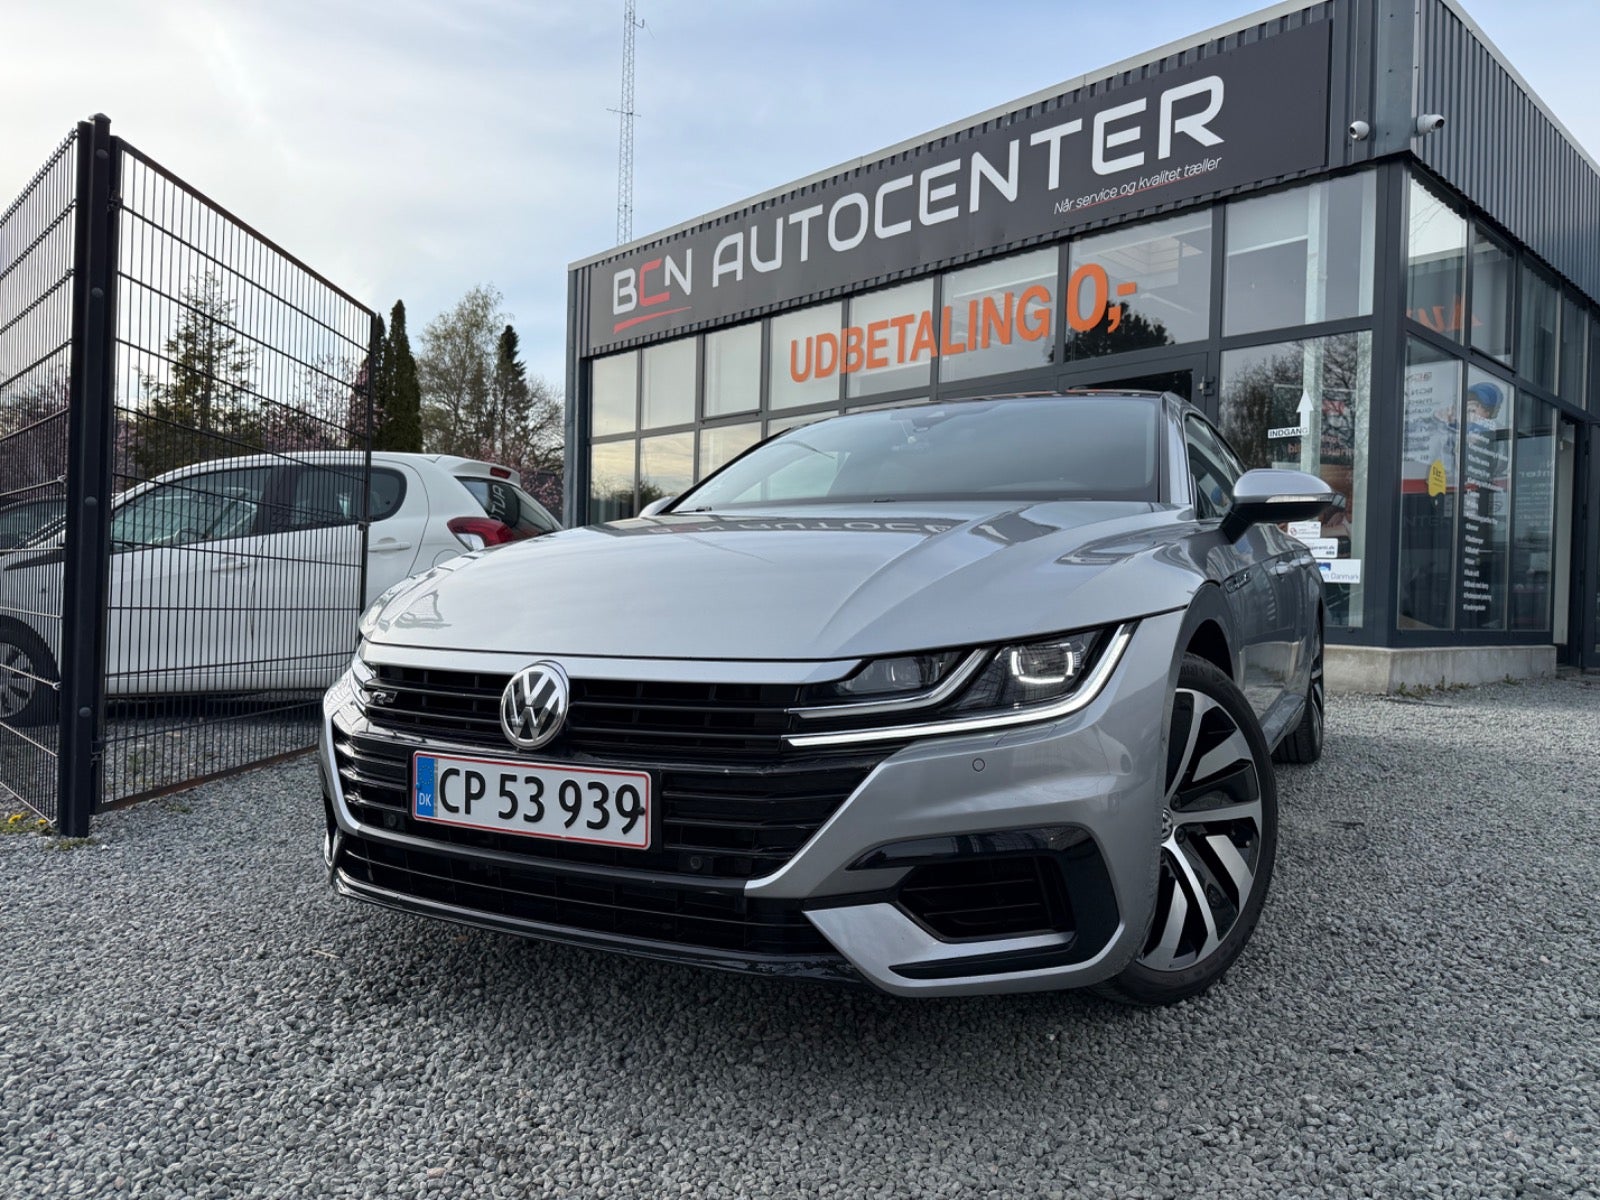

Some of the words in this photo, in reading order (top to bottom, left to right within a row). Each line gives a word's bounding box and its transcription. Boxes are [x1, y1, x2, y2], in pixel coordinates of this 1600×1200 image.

[613, 248, 692, 315] BCN
[712, 75, 1225, 288] AUTOCENTER
[1053, 198, 1074, 215] Når
[1075, 187, 1118, 207] service
[1119, 180, 1136, 195] og
[1138, 168, 1182, 188] kvalitet
[1183, 157, 1223, 178] tæller
[790, 284, 1052, 384] UDBETALING
[1269, 427, 1308, 437] INDGANG
[418, 791, 432, 807] DK
[439, 767, 486, 816] CP
[498, 773, 545, 823] 53
[558, 779, 642, 835] 939
